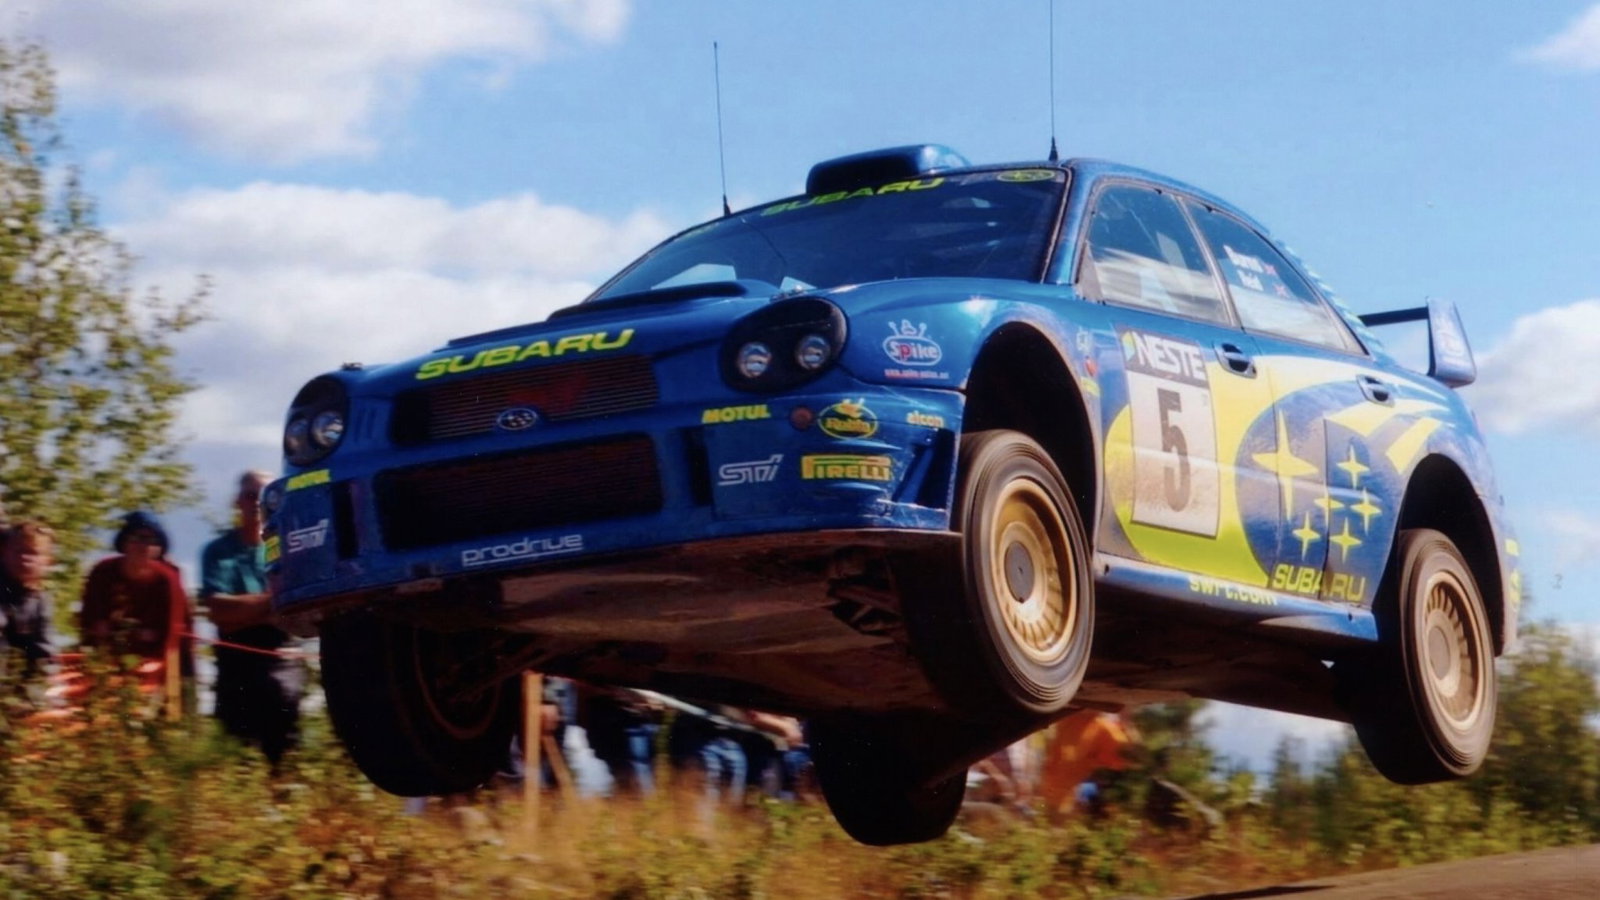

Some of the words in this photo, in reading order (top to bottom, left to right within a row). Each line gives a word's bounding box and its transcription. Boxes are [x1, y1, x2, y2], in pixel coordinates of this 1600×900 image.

[761, 177, 945, 216] SUBARU
[415, 329, 635, 380] SUBARU
[889, 341, 938, 360] Spike
[1132, 331, 1207, 382] NESTE
[702, 405, 771, 424] MOTUL
[801, 455, 892, 480] PIRELLI
[1157, 387, 1191, 512] 5
[462, 534, 583, 567] prodrive
[1272, 564, 1366, 602] SUBARU
